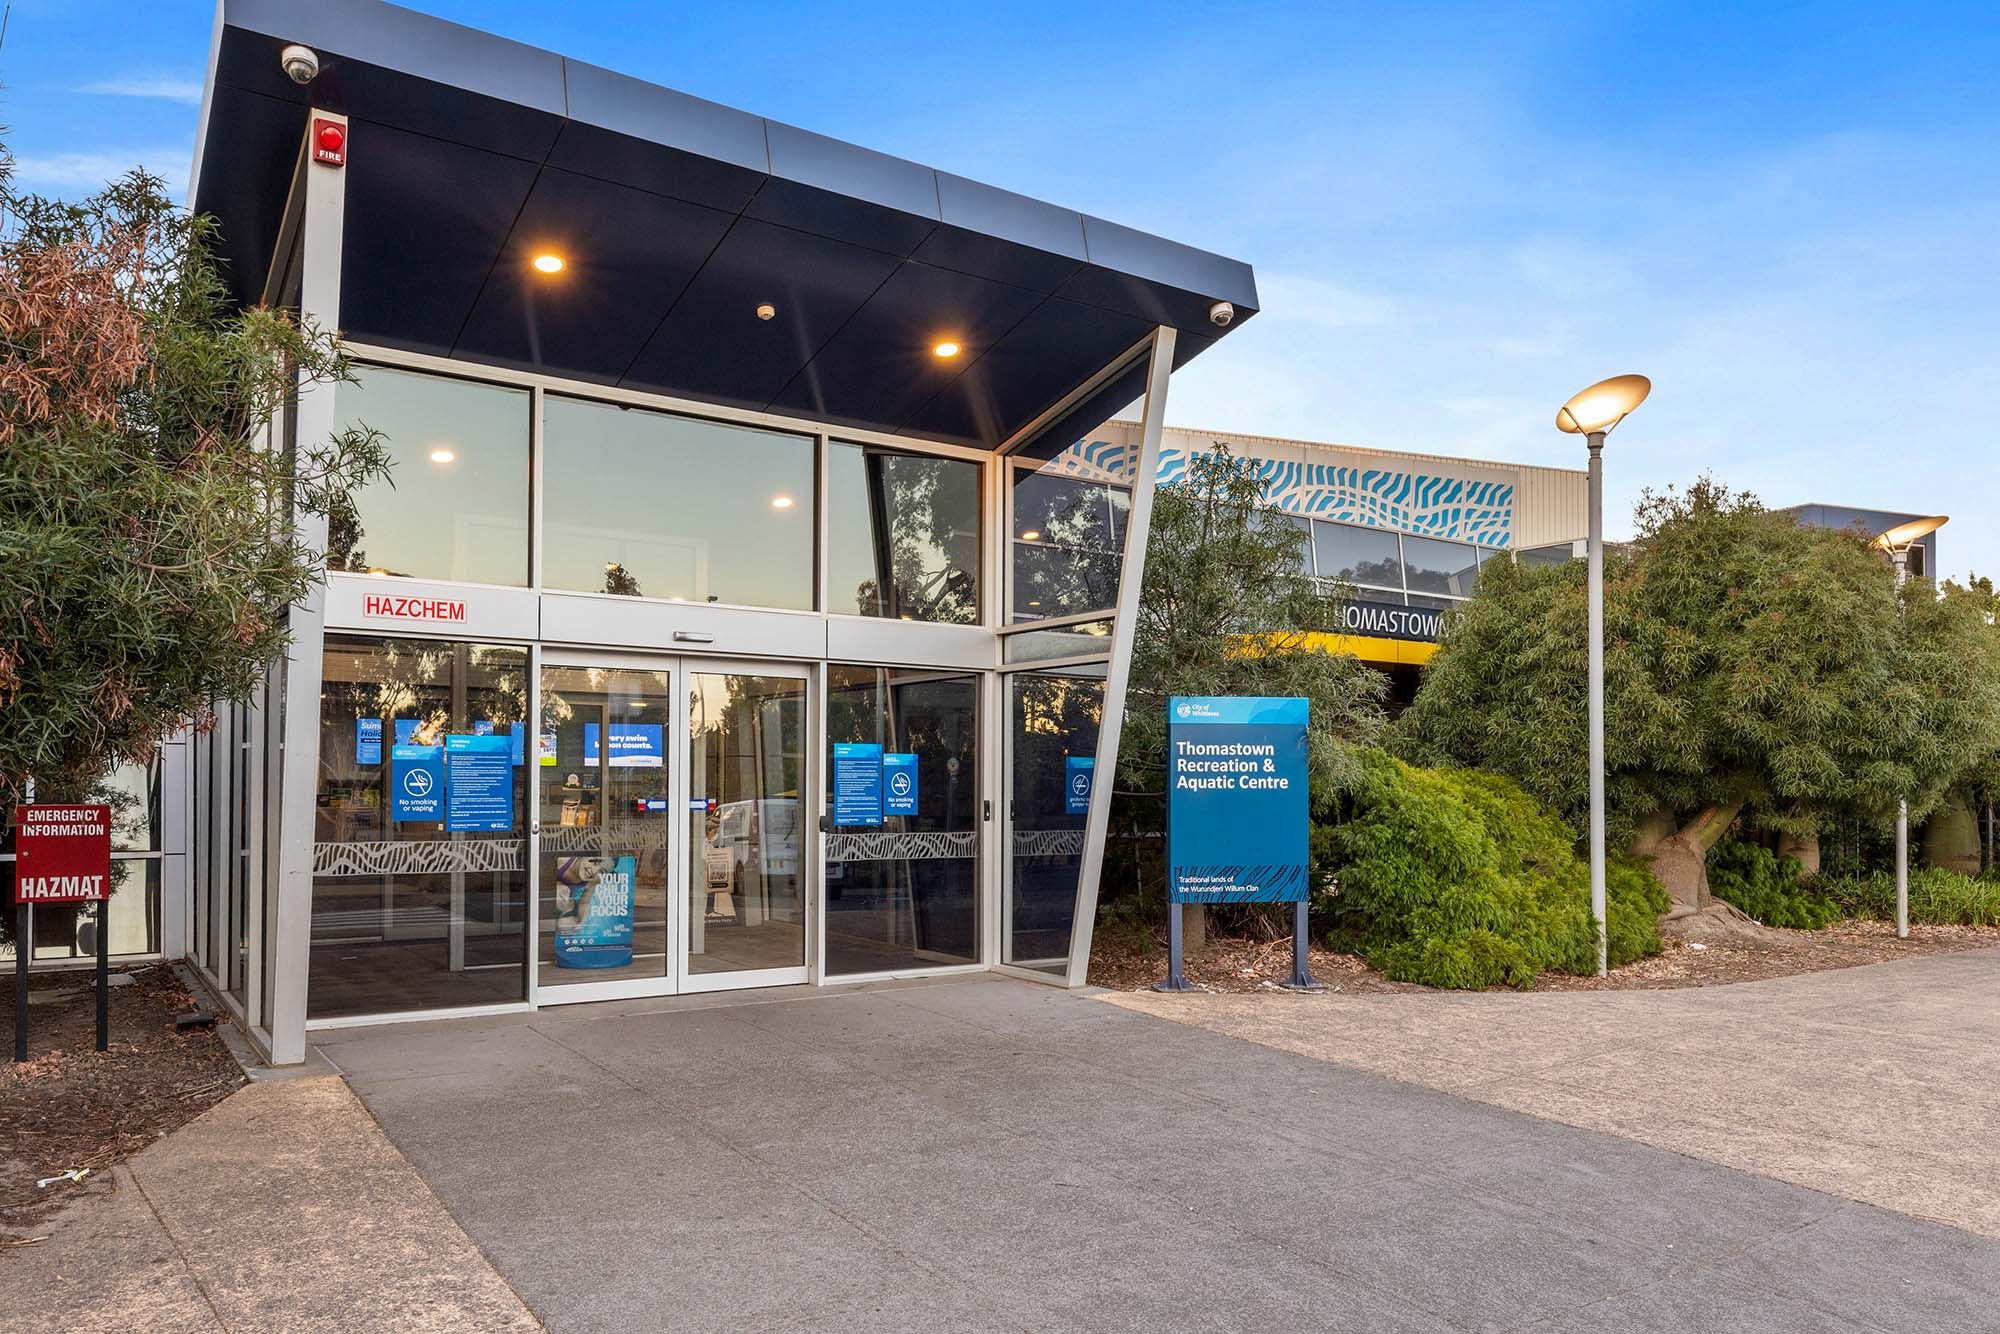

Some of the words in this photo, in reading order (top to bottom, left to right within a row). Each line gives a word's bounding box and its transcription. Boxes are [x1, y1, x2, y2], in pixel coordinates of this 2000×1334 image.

[319, 150, 341, 161] FIRE
[367, 596, 465, 620] HAZCHEM
[626, 734, 648, 742] swim
[1176, 741, 1275, 756] Thomastown
[1178, 759, 1258, 772] Recreation
[1263, 759, 1275, 772] &
[1177, 776, 1235, 793] Aquatic
[1239, 776, 1289, 790] Centre
[27, 810, 99, 822] EMERGENCY
[22, 825, 104, 836] INFORMATION
[598, 873, 629, 885] YOUR
[21, 876, 103, 899] HAZMAT
[595, 884, 629, 895] CHILD
[599, 894, 629, 906] YOUR
[591, 905, 629, 917] FOCUS
